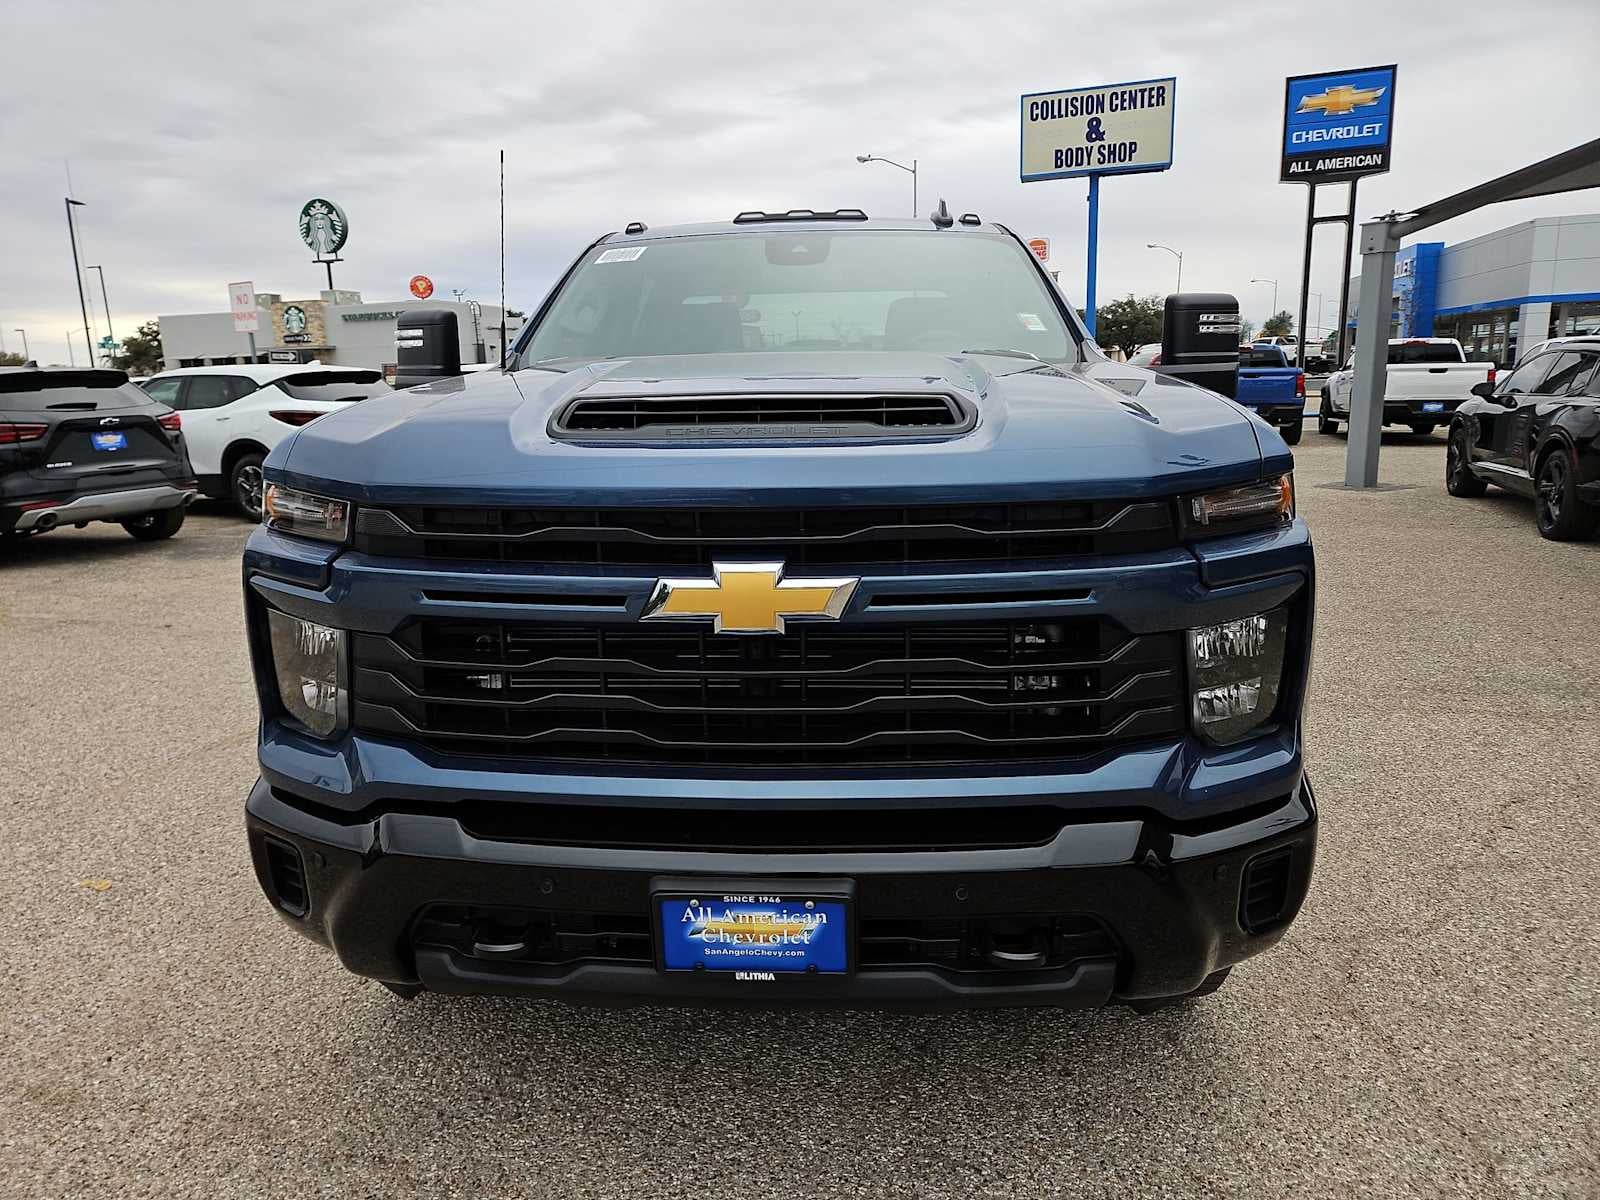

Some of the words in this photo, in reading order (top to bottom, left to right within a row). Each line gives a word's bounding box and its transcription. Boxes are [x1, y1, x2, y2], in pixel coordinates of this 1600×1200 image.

[1030, 93, 1105, 122] COLLISION
[1109, 85, 1166, 113] CENTER
[1085, 116, 1106, 143] &
[1291, 123, 1384, 144] CHEVROLET
[1054, 145, 1094, 169] BODY
[1097, 141, 1138, 165] SHOP
[1289, 160, 1313, 173] ALL
[1315, 154, 1383, 171] AMERICAN
[236, 293, 249, 305] NO
[664, 425, 850, 438] CHEVROLET
[723, 895, 756, 904] SINCE
[681, 906, 713, 924] All
[721, 908, 828, 925] American
[700, 927, 811, 946] Chevrolet
[704, 946, 806, 958] SanAngeloChevy.com
[744, 971, 776, 981] LITHIA
